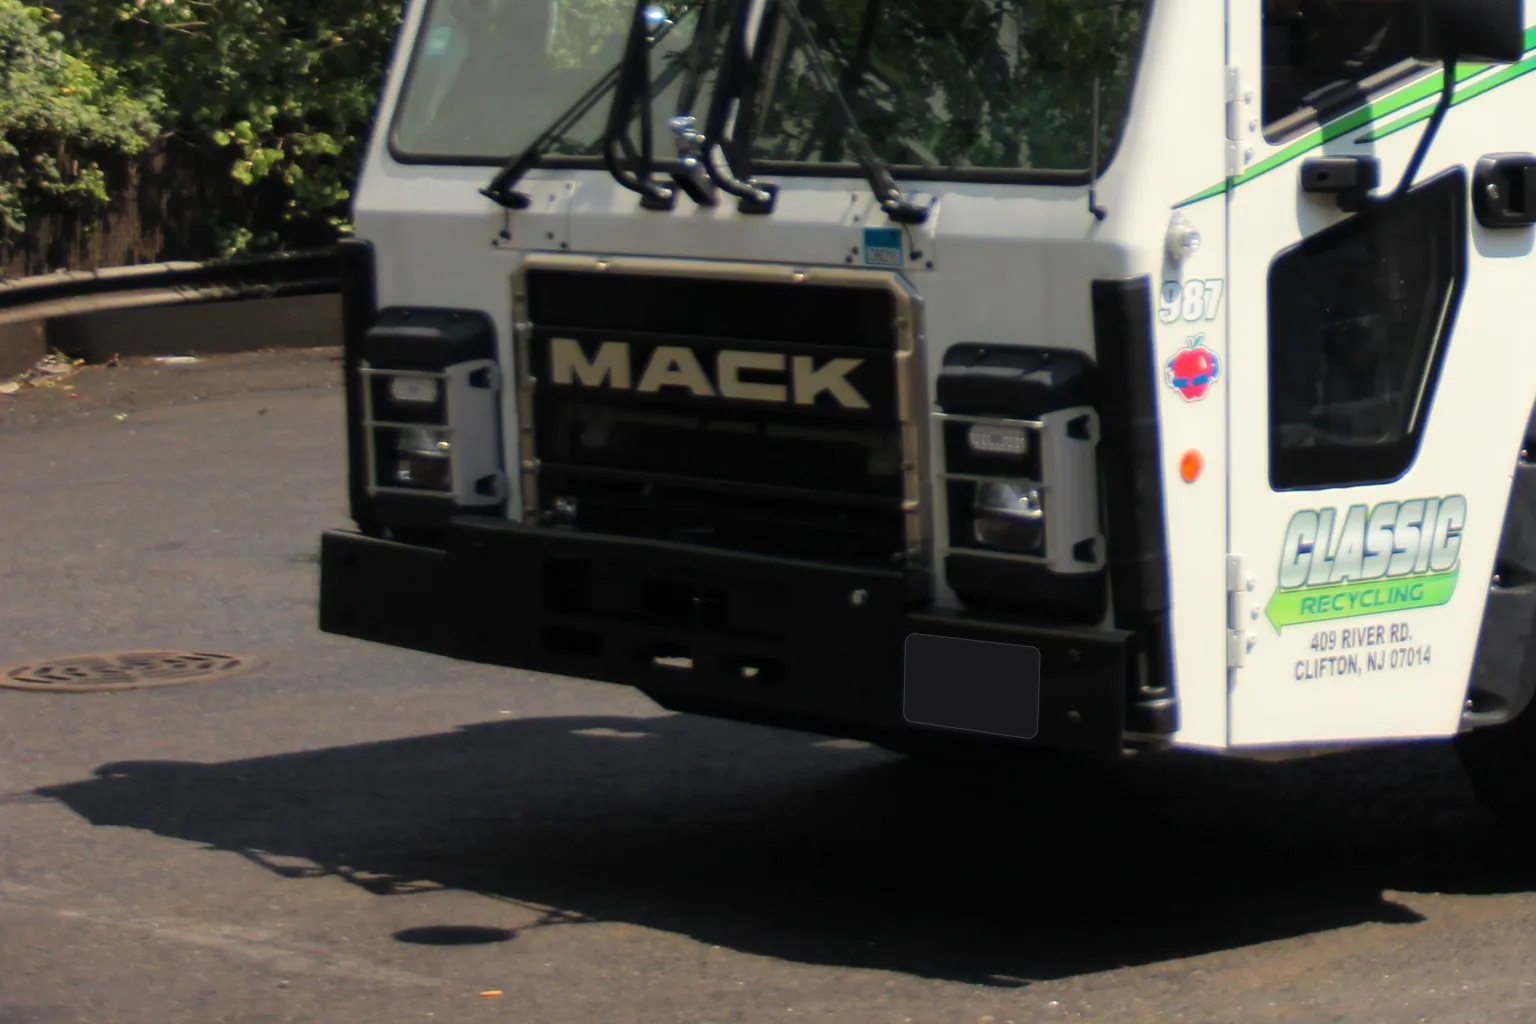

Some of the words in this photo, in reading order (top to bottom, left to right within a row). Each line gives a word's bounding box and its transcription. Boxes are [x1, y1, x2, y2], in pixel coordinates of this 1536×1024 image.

[1158, 278, 1224, 325] 987
[550, 337, 872, 409] MACK
[1280, 494, 1467, 590] CLASSIC
[1300, 583, 1425, 616] RECYCLING
[1310, 631, 1337, 652] 409
[1341, 625, 1385, 650] RIVER
[1390, 622, 1412, 643] RD.
[1294, 653, 1362, 681] CLIFTON,
[1367, 650, 1386, 672] NJ
[1390, 644, 1432, 669] 07014
